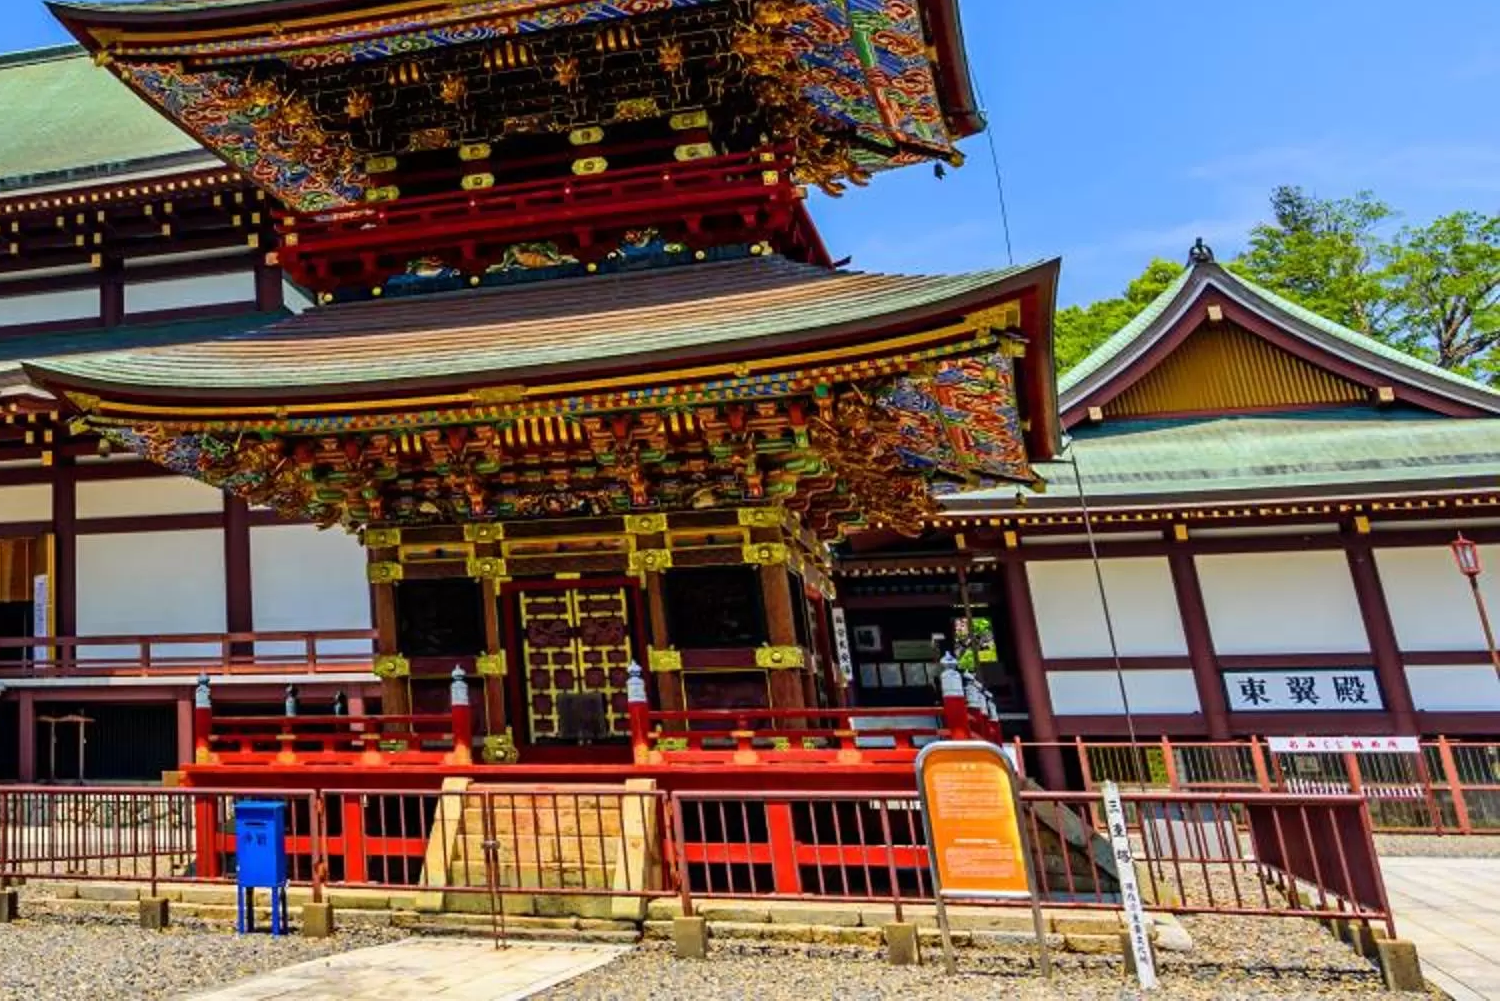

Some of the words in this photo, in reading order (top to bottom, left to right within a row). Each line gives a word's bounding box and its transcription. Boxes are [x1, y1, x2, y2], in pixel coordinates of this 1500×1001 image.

[1237, 676, 1369, 705] 東翼殿
[1108, 799, 1130, 863] 三重塔
